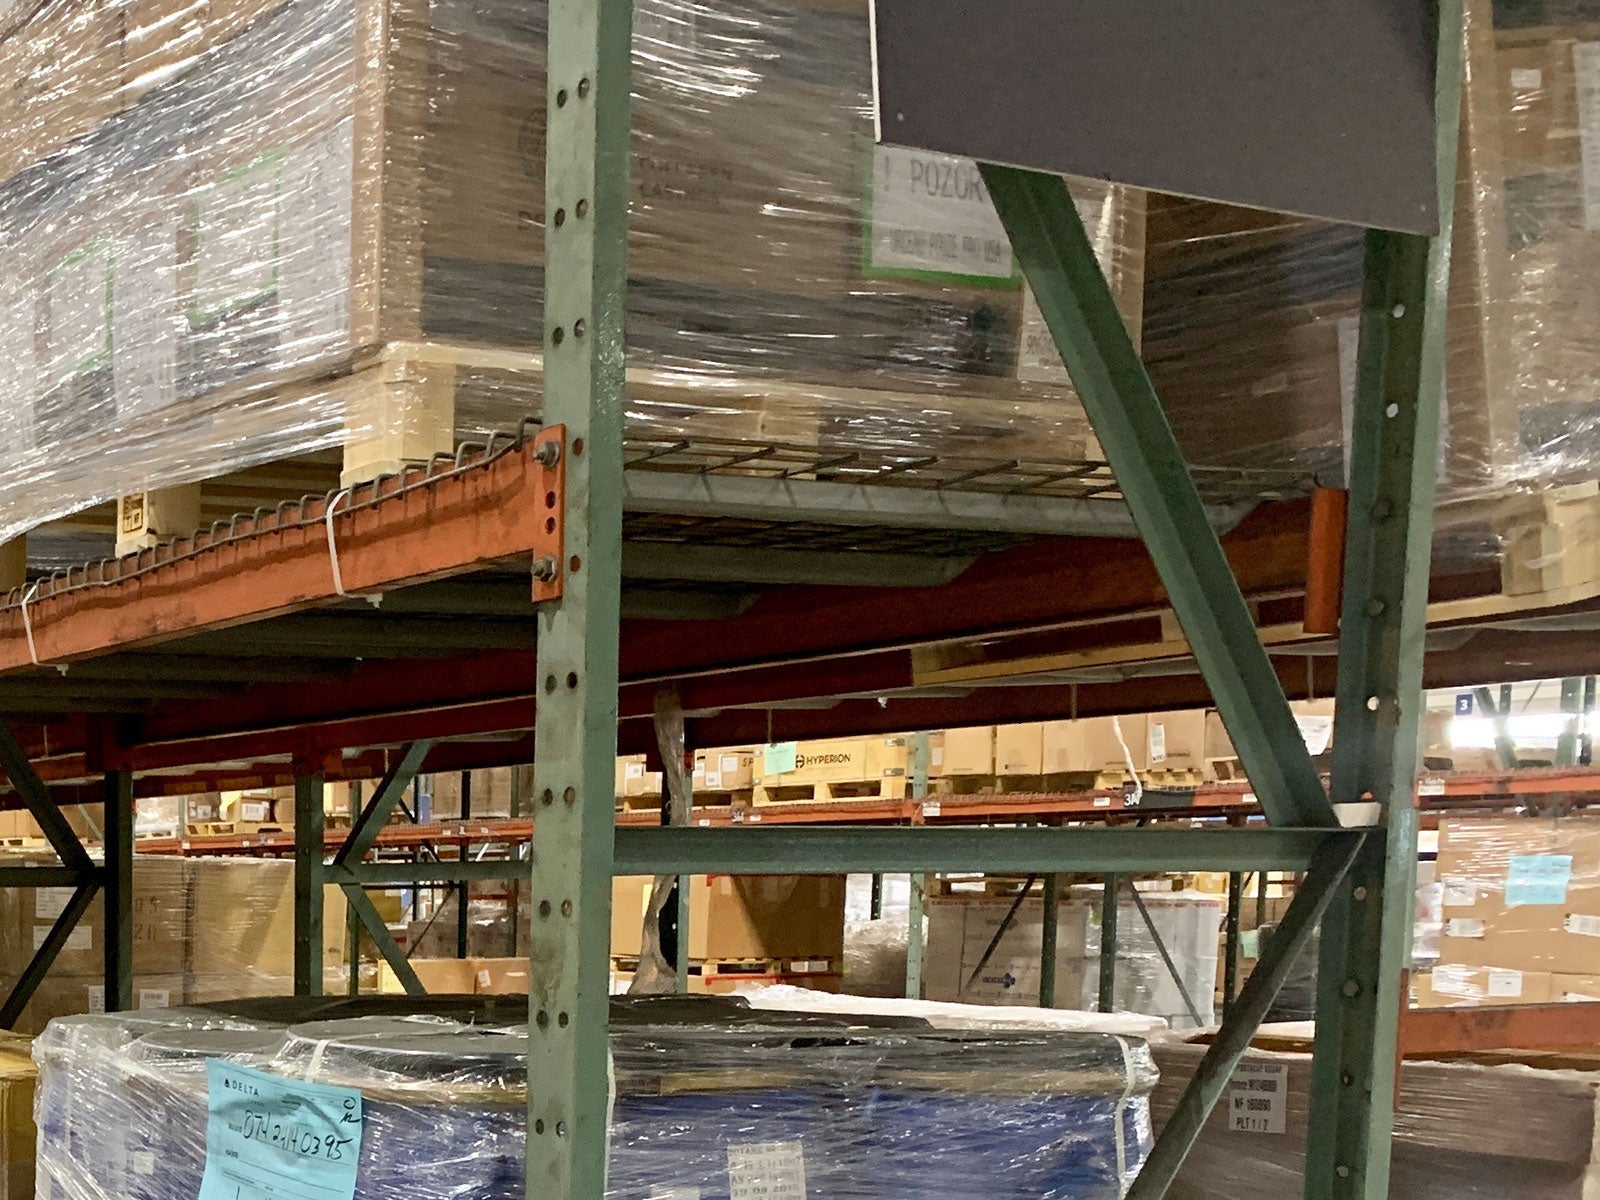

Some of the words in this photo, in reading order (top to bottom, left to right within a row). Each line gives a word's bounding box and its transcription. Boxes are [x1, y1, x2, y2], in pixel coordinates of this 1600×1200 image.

[1460, 699, 1469, 711] 3
[806, 753, 851, 766] HYPERION
[232, 1080, 260, 1097] DELTA
